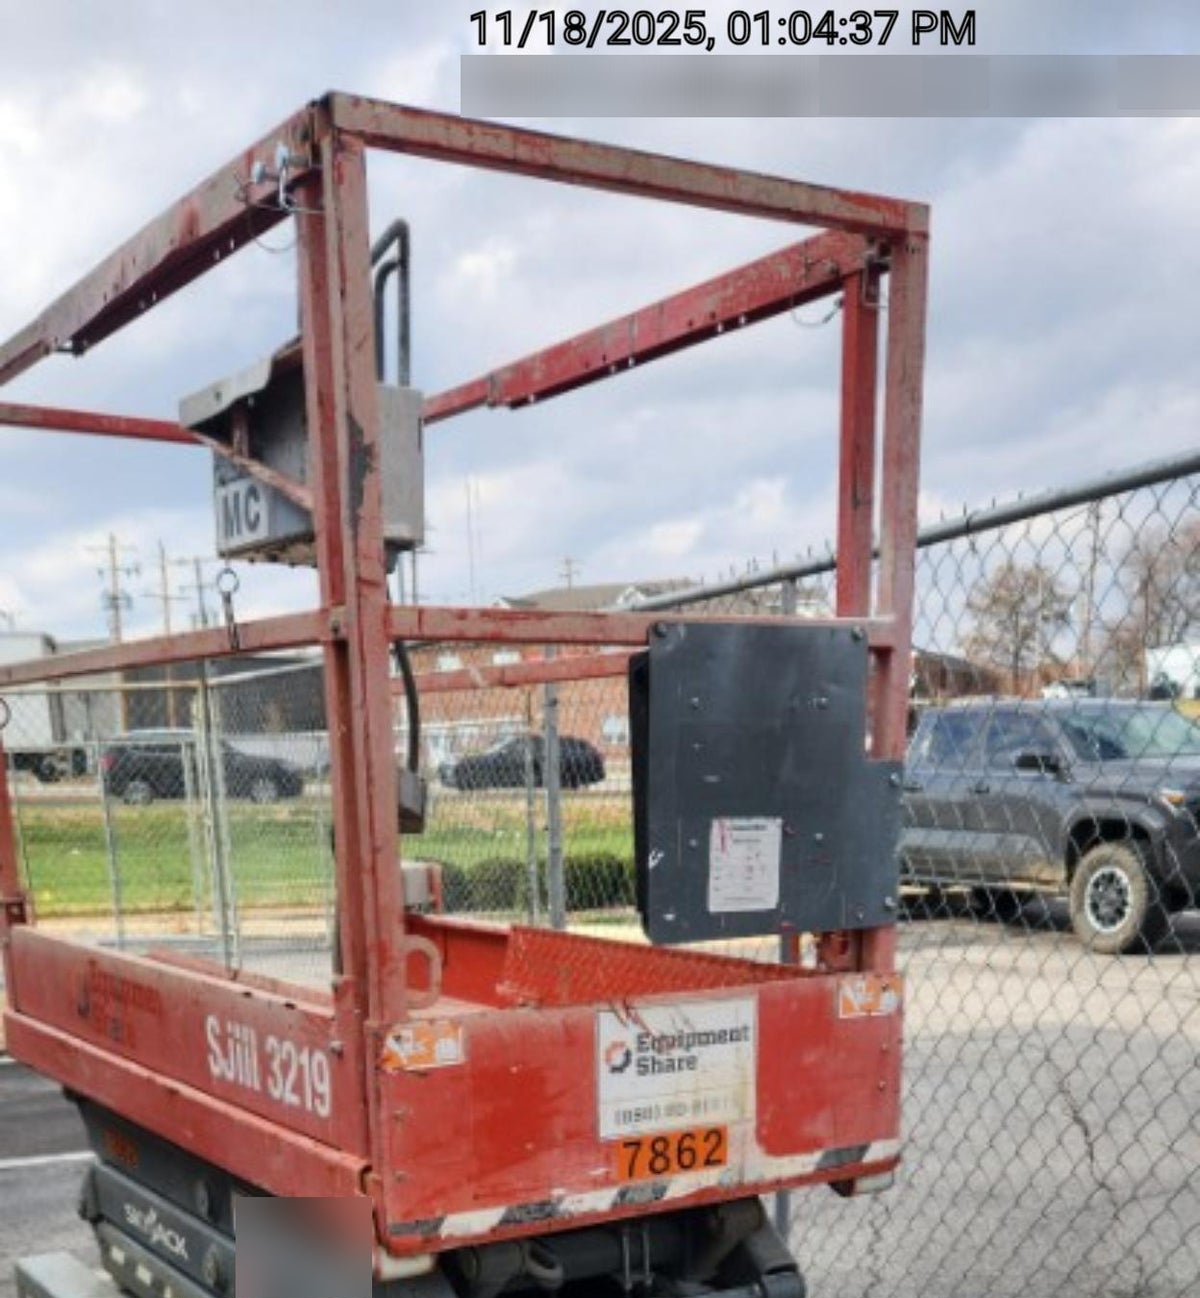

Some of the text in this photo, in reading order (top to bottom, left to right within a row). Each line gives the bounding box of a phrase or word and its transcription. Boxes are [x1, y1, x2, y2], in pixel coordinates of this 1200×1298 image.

[222, 484, 261, 538] MC
[637, 1026, 750, 1054] Equipment
[637, 1055, 698, 1076] Share
[265, 1034, 330, 1117] 3219
[621, 1128, 723, 1179] 7862
